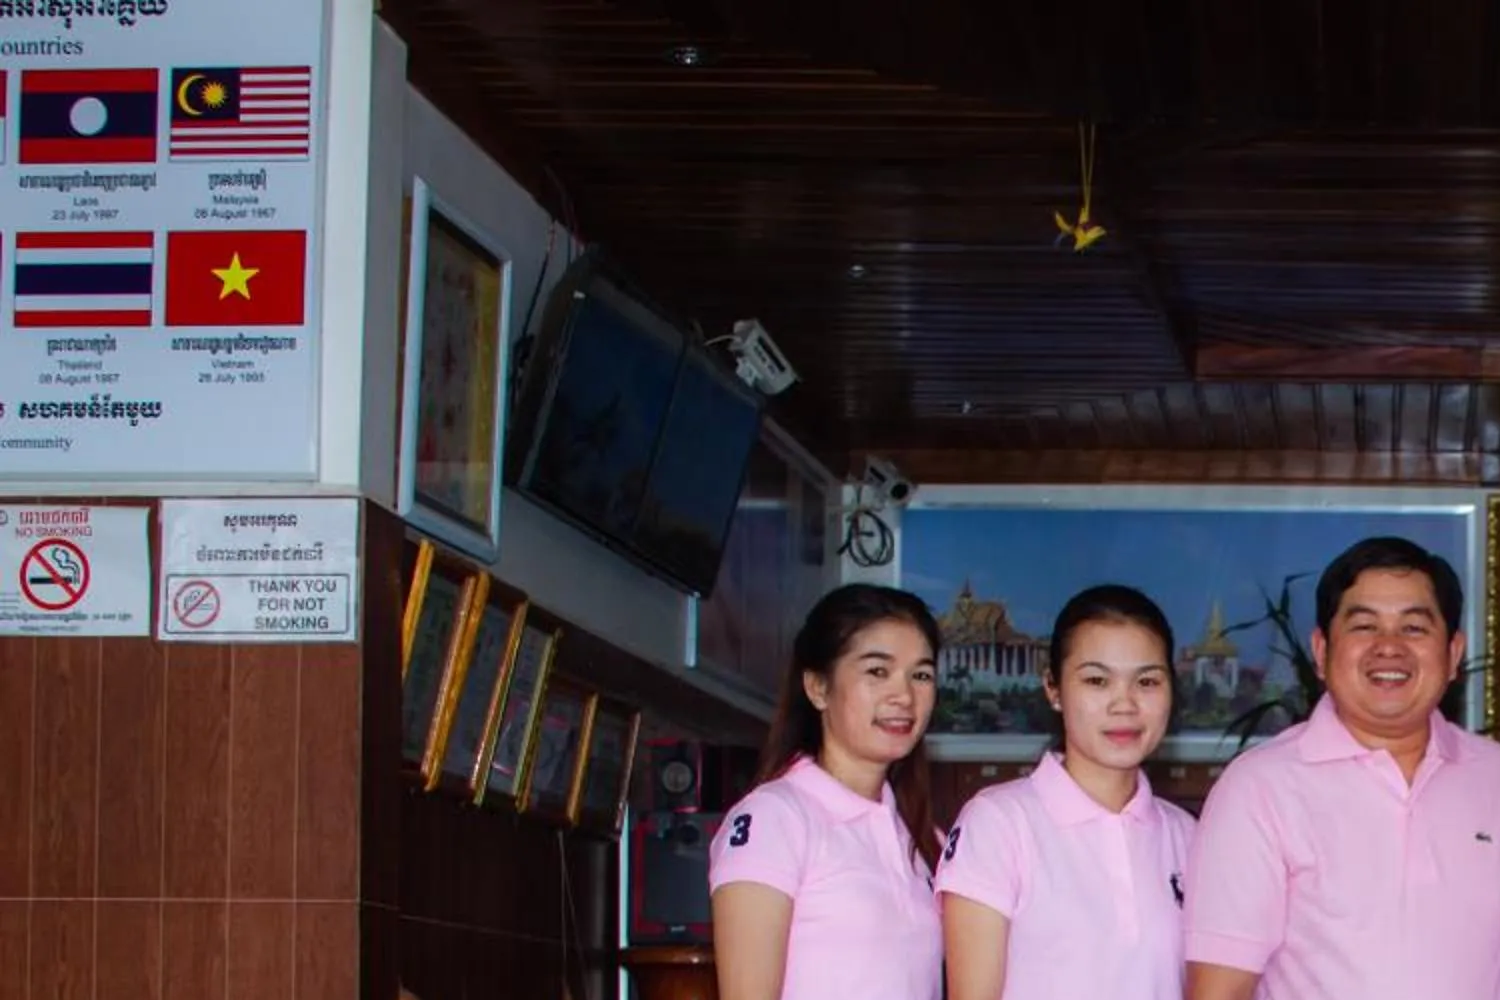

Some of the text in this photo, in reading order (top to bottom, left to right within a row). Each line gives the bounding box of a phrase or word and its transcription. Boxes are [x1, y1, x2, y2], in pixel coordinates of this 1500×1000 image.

[0, 36, 84, 56] ountries
[249, 579, 337, 594] THANK YOU
[258, 597, 326, 611] FOR NOT
[254, 615, 329, 630] SMOKING
[729, 813, 753, 848] 3
